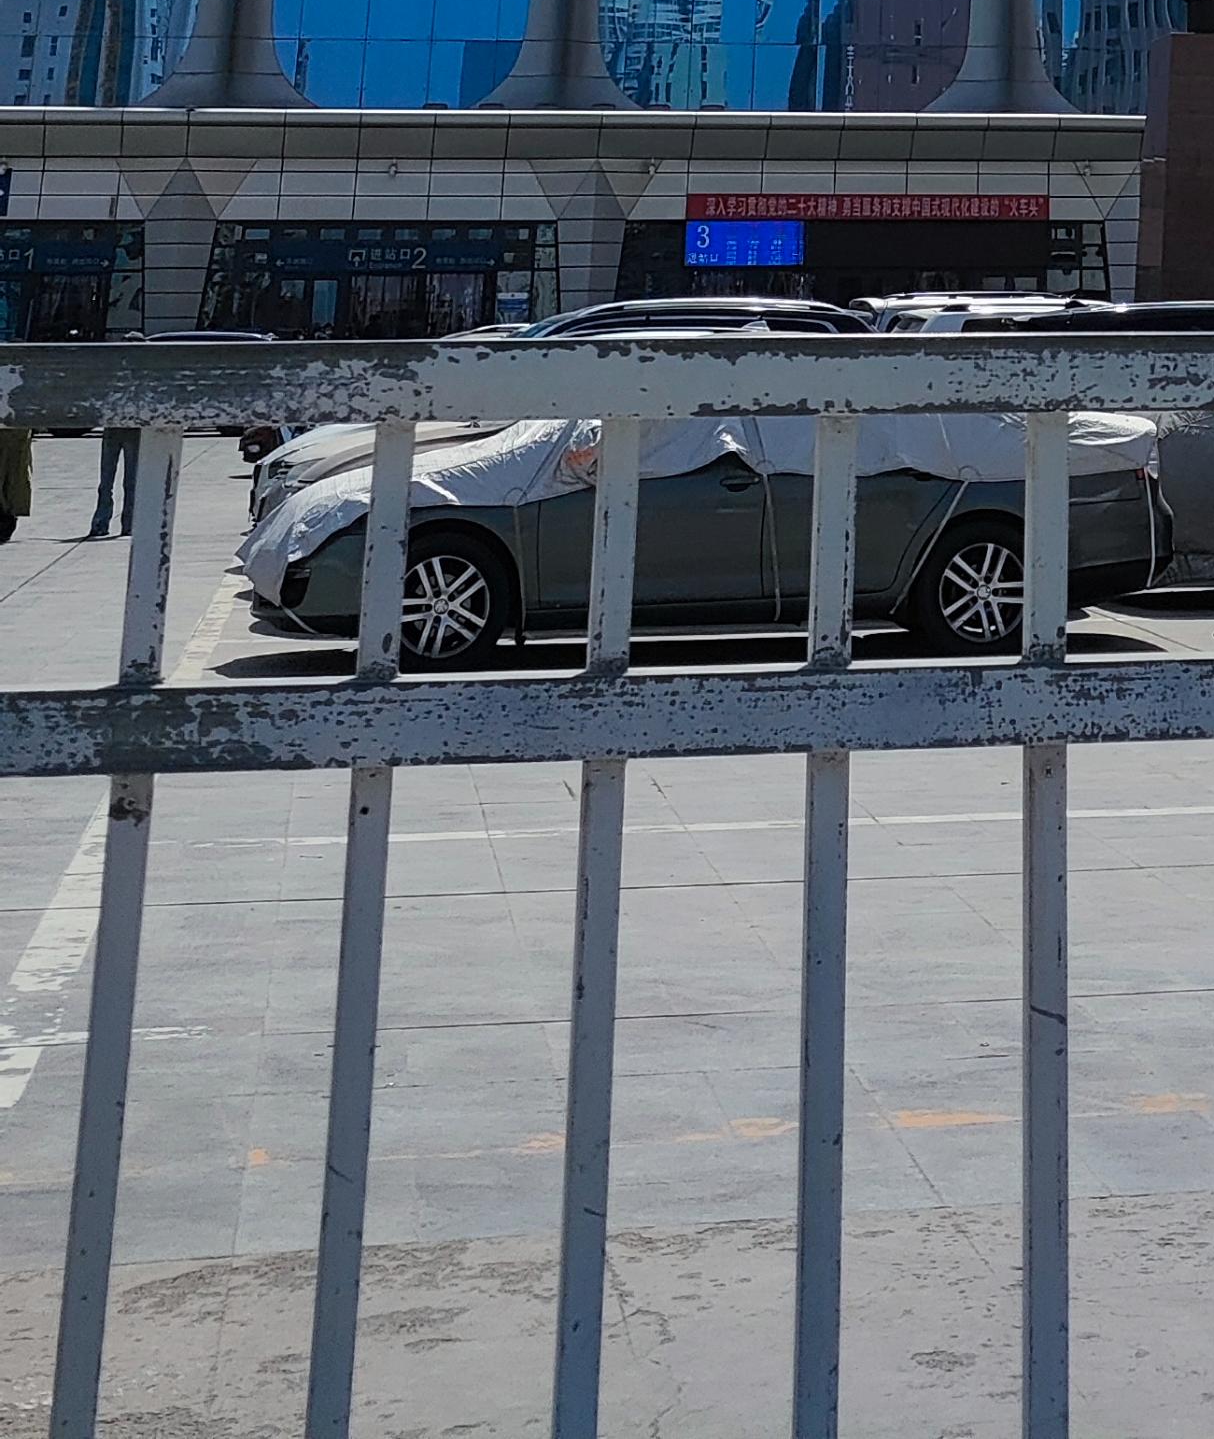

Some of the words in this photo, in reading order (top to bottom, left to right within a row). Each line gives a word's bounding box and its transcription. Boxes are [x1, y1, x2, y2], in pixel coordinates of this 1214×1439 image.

[705, 196, 837, 217] 深入学习贯彻党的二十大精神
[697, 225, 710, 248] 3
[24, 248, 34, 270] 1
[370, 248, 411, 260] 进站口
[411, 247, 427, 269] 2
